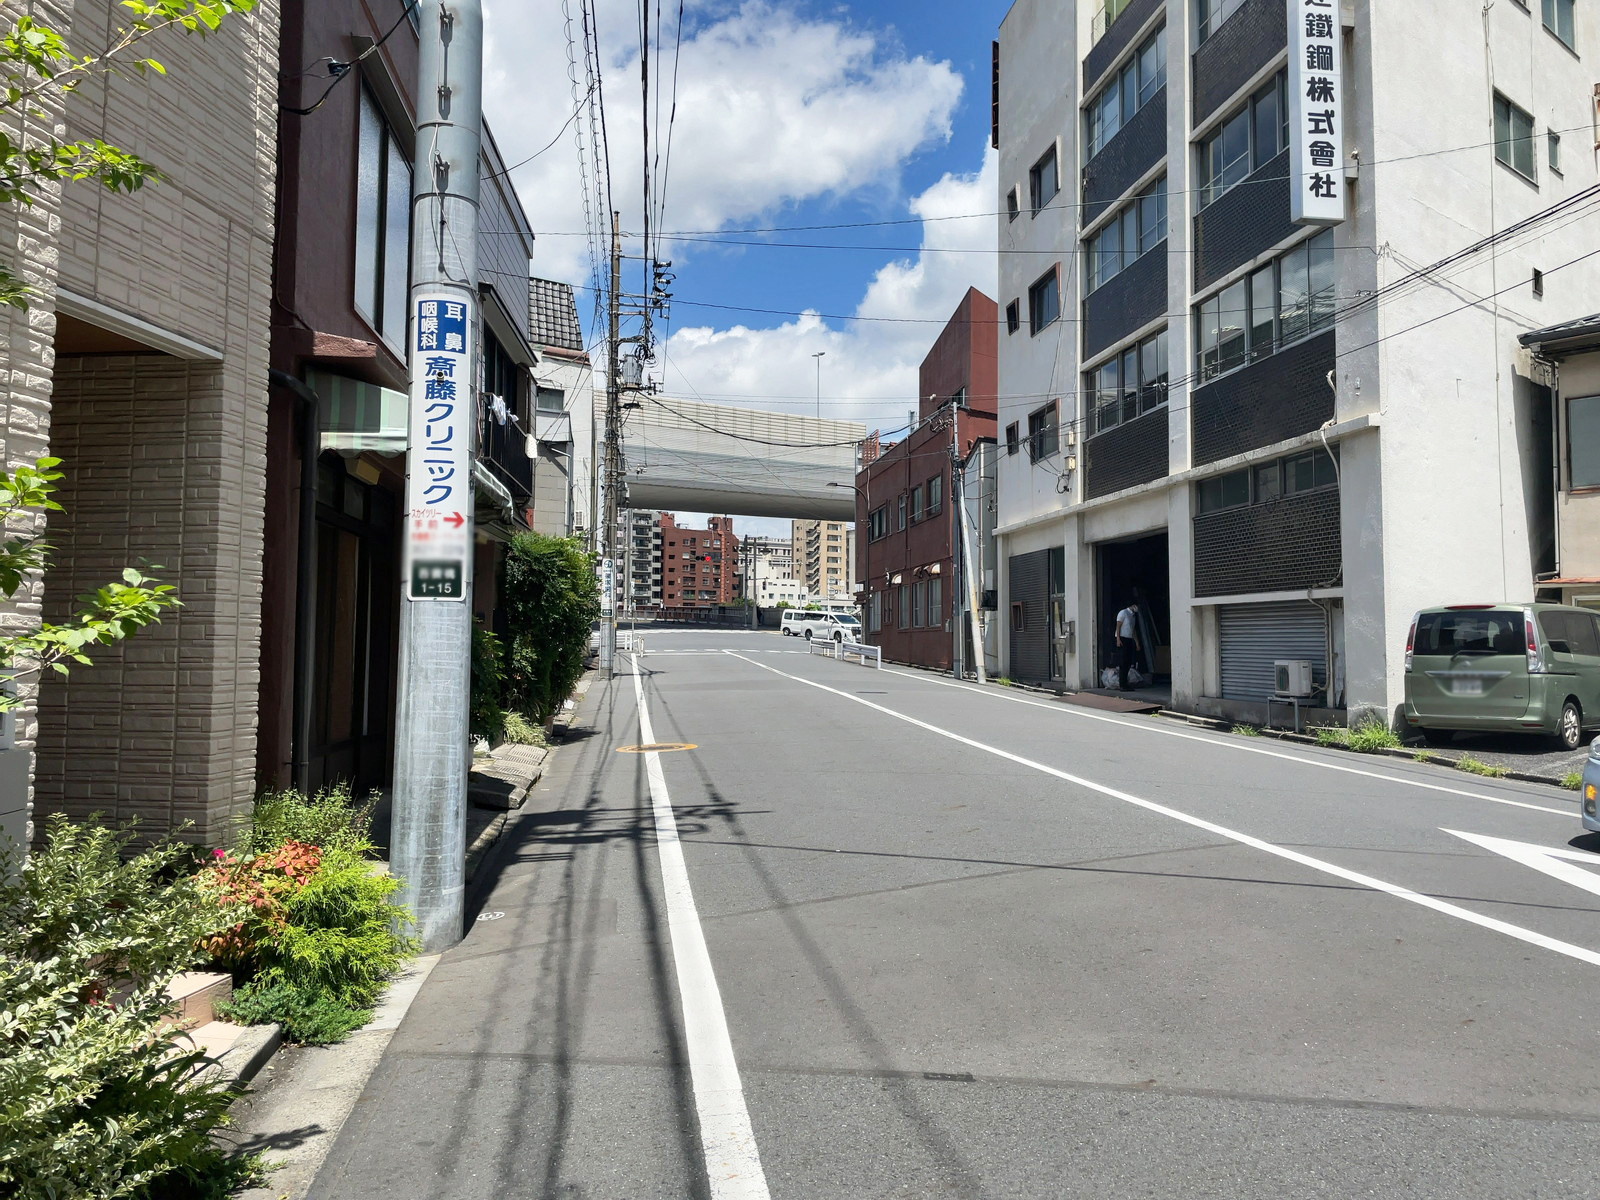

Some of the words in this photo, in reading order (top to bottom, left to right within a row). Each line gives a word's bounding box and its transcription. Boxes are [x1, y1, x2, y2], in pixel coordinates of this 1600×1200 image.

[1304, 0, 1337, 198] 鐵鋼株式會社
[420, 302, 438, 349] 咽喉科
[445, 303, 463, 351] 耳鼻
[423, 355, 457, 504] 斎藤クリニック
[411, 508, 442, 518] スカイツリー
[421, 582, 452, 594] 1-15
